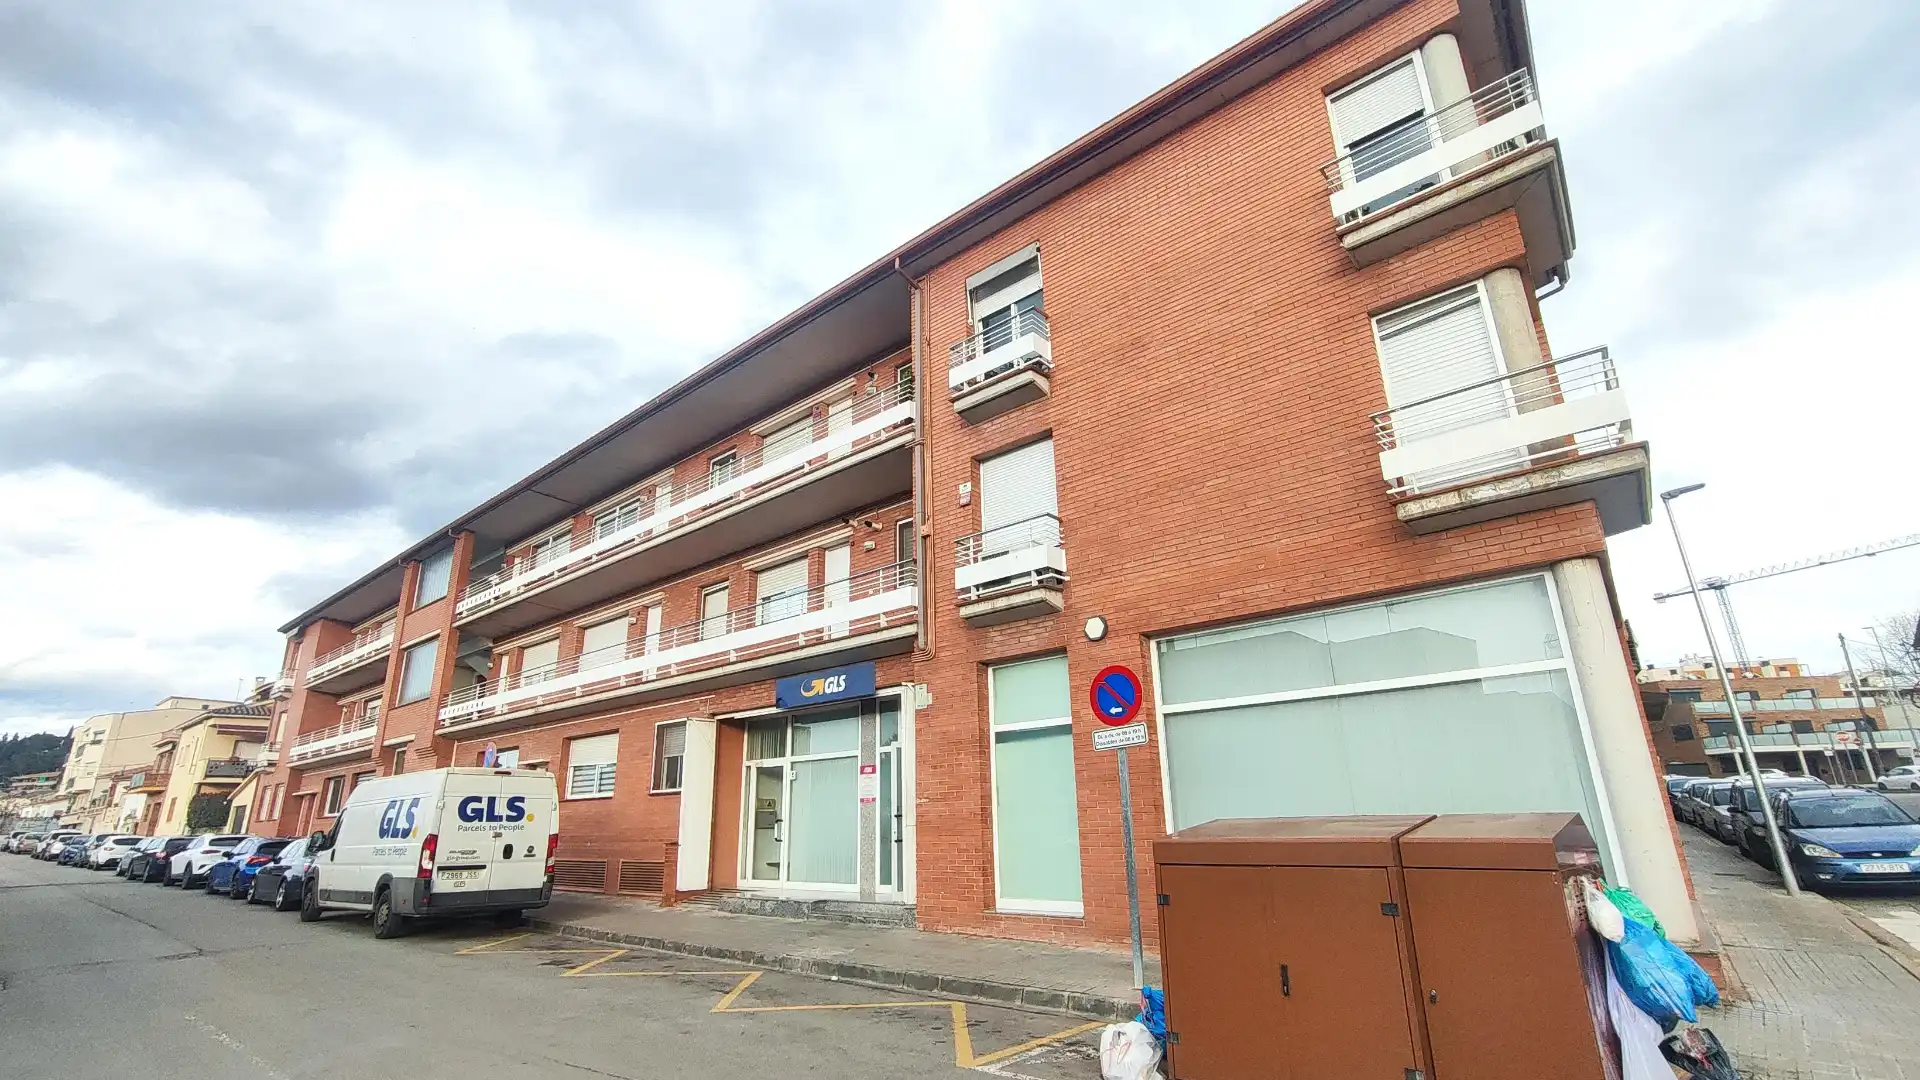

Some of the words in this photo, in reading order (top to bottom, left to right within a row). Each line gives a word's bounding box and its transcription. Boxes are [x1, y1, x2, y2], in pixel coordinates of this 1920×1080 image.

[824, 674, 847, 694] GLS
[457, 824, 487, 832] Parcels
[488, 824, 497, 832] to
[498, 823, 525, 833] People
